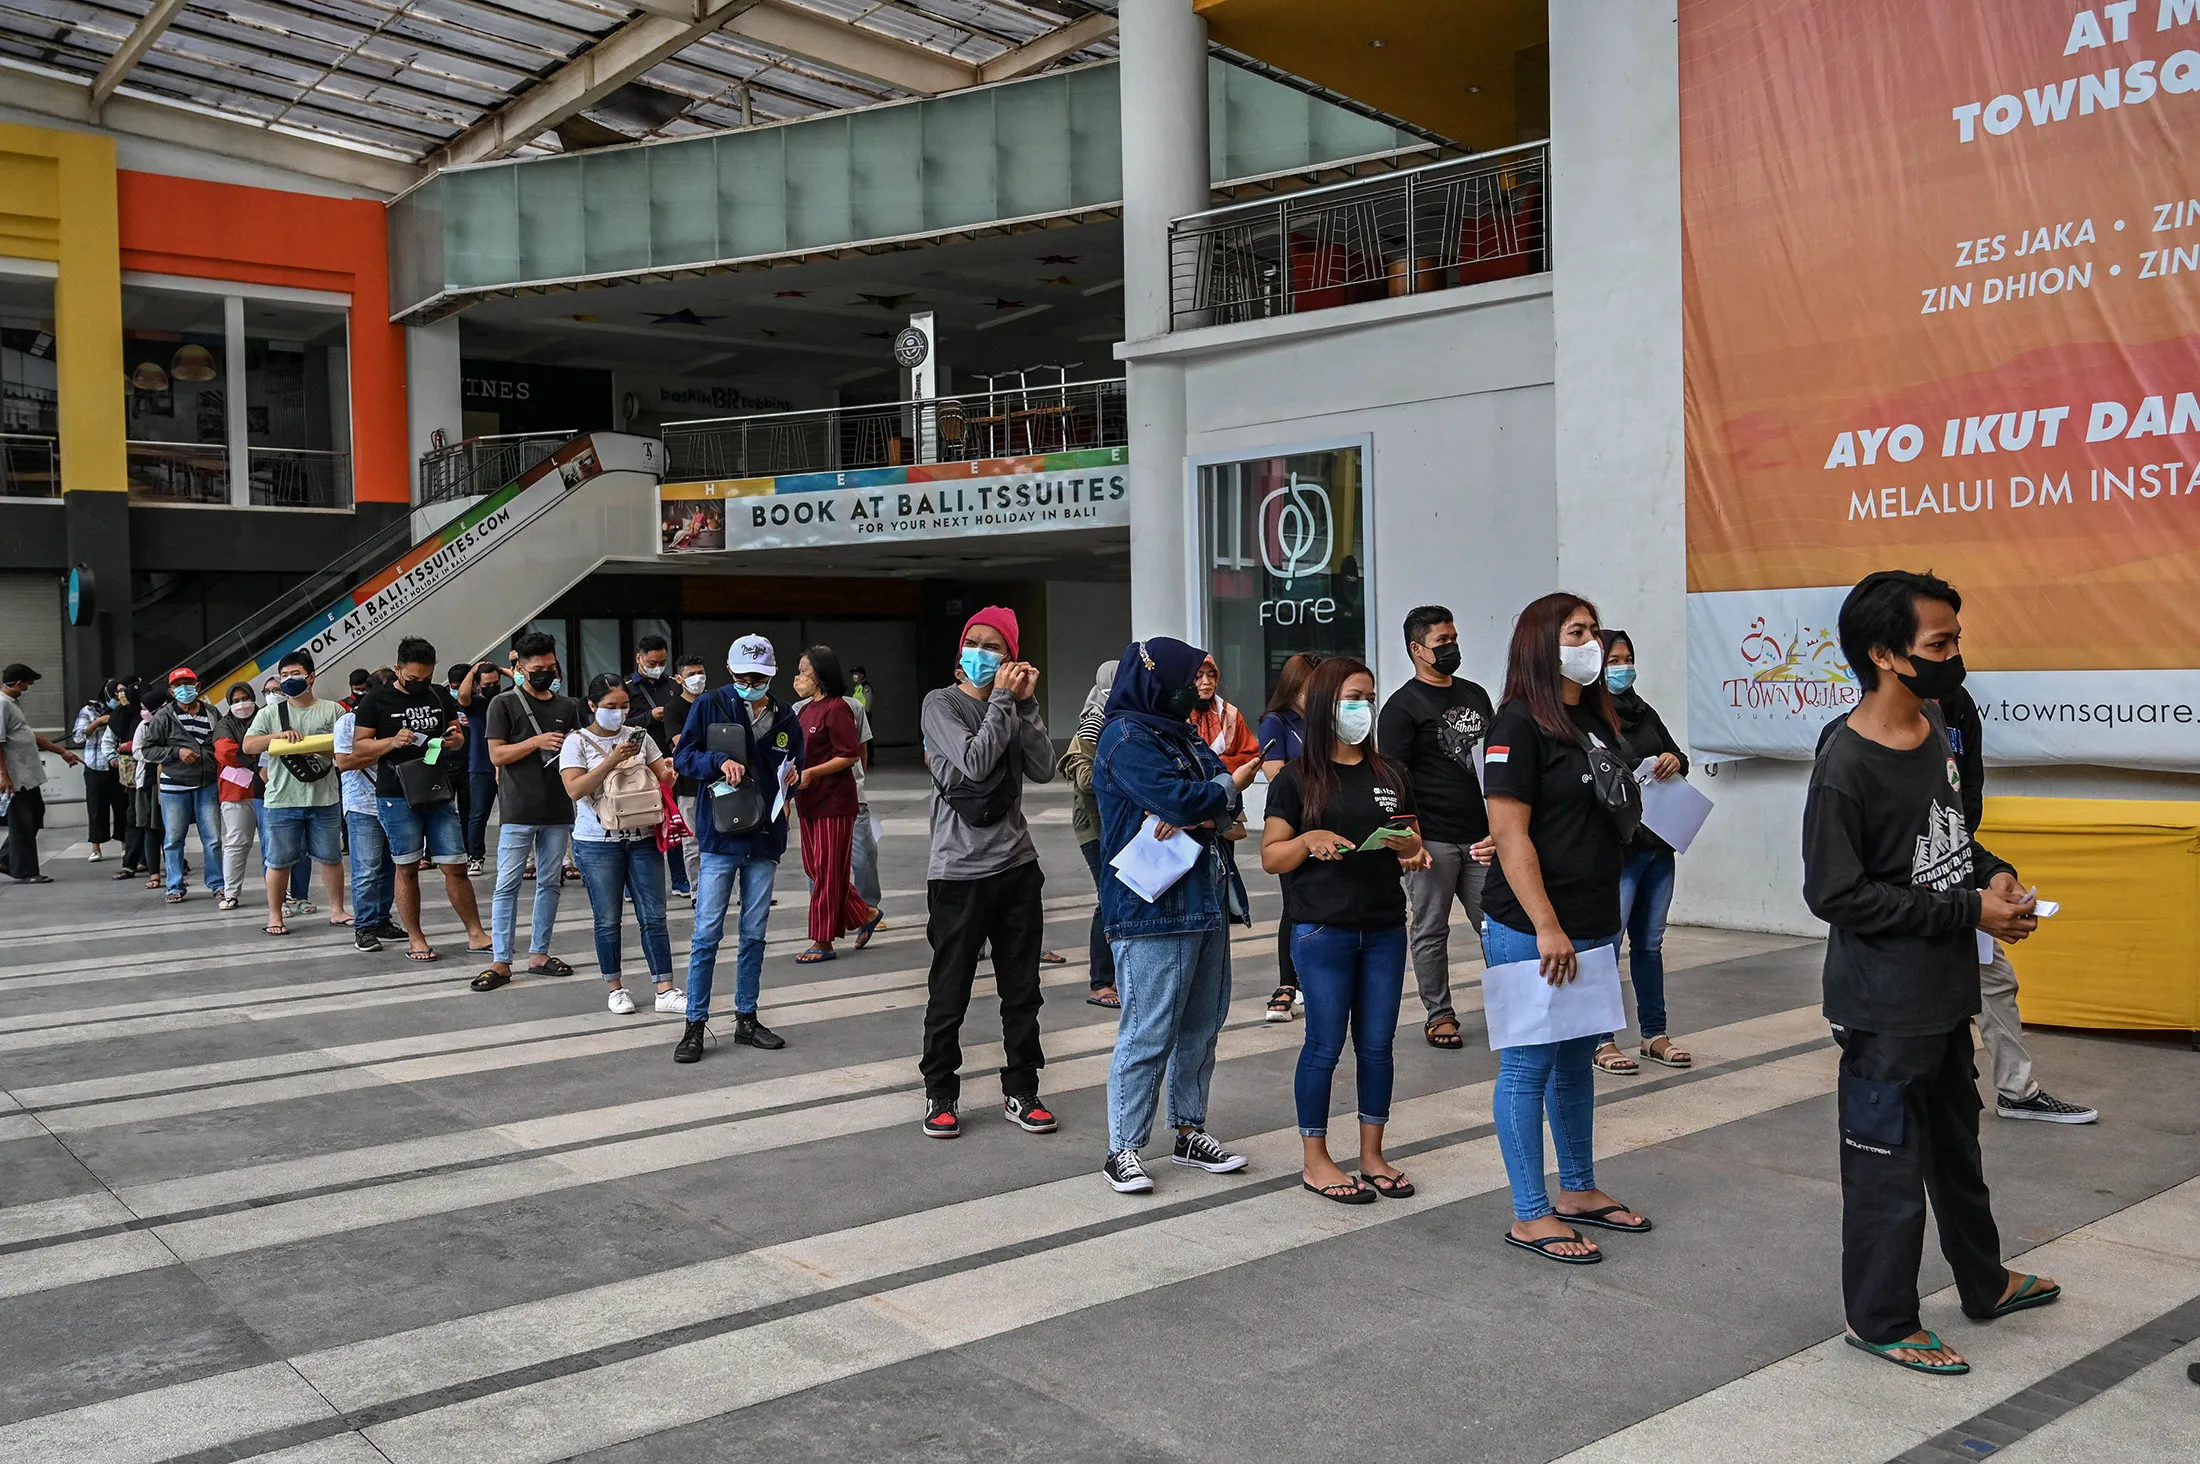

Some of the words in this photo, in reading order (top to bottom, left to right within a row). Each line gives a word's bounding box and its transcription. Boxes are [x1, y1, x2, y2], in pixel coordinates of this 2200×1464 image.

[2063, 0, 2137, 56] AT
[1955, 234, 2006, 267] ZES
[2014, 218, 2096, 257] JAKA
[1921, 282, 1972, 314] ZIN
[1982, 262, 2092, 304] DHION
[2138, 243, 2200, 279] ZIN
[1824, 423, 1925, 470] AYO
[1941, 406, 2070, 458] IKUT
[751, 500, 836, 527] BOOK
[850, 496, 884, 520] AT
[898, 475, 1125, 517] BALI.TSSUITES
[858, 523, 884, 533] FOR
[890, 520, 926, 532] YOUR
[933, 516, 969, 528] NEXT
[975, 511, 1036, 525] HOLIDAY
[1042, 509, 1057, 521] IN
[1064, 506, 1097, 519] BALI
[1848, 478, 1993, 521] MELALUI
[2010, 470, 2073, 508] DM
[343, 610, 362, 635] AT
[365, 507, 510, 617] BALI.TSSUITES.COM
[351, 625, 367, 639] FOR
[368, 610, 389, 627] YOUR
[390, 595, 409, 612] NEXT
[410, 573, 440, 597] HOLIDAY
[441, 567, 450, 576] IN
[451, 555, 467, 569] BALI
